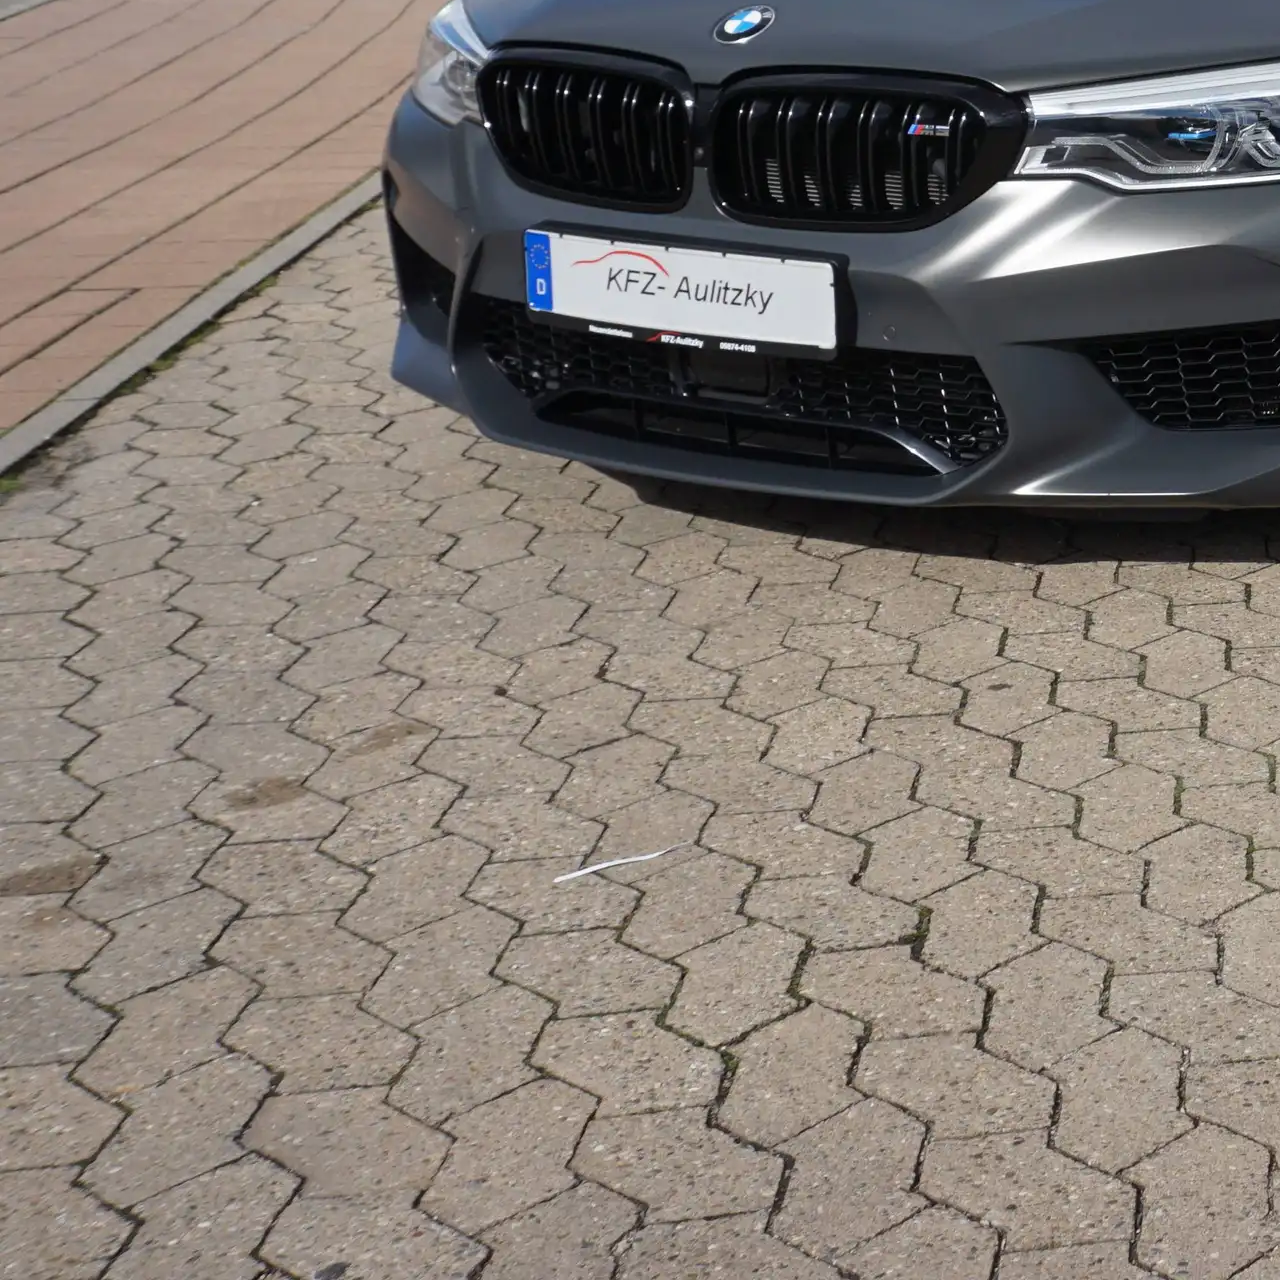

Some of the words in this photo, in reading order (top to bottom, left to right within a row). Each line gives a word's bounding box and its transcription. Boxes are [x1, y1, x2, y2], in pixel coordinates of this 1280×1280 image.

[536, 278, 547, 296] D
[607, 267, 666, 296] KFZ-
[673, 275, 774, 315] Aulitzky
[661, 334, 704, 349] KFZ-Aulitzky
